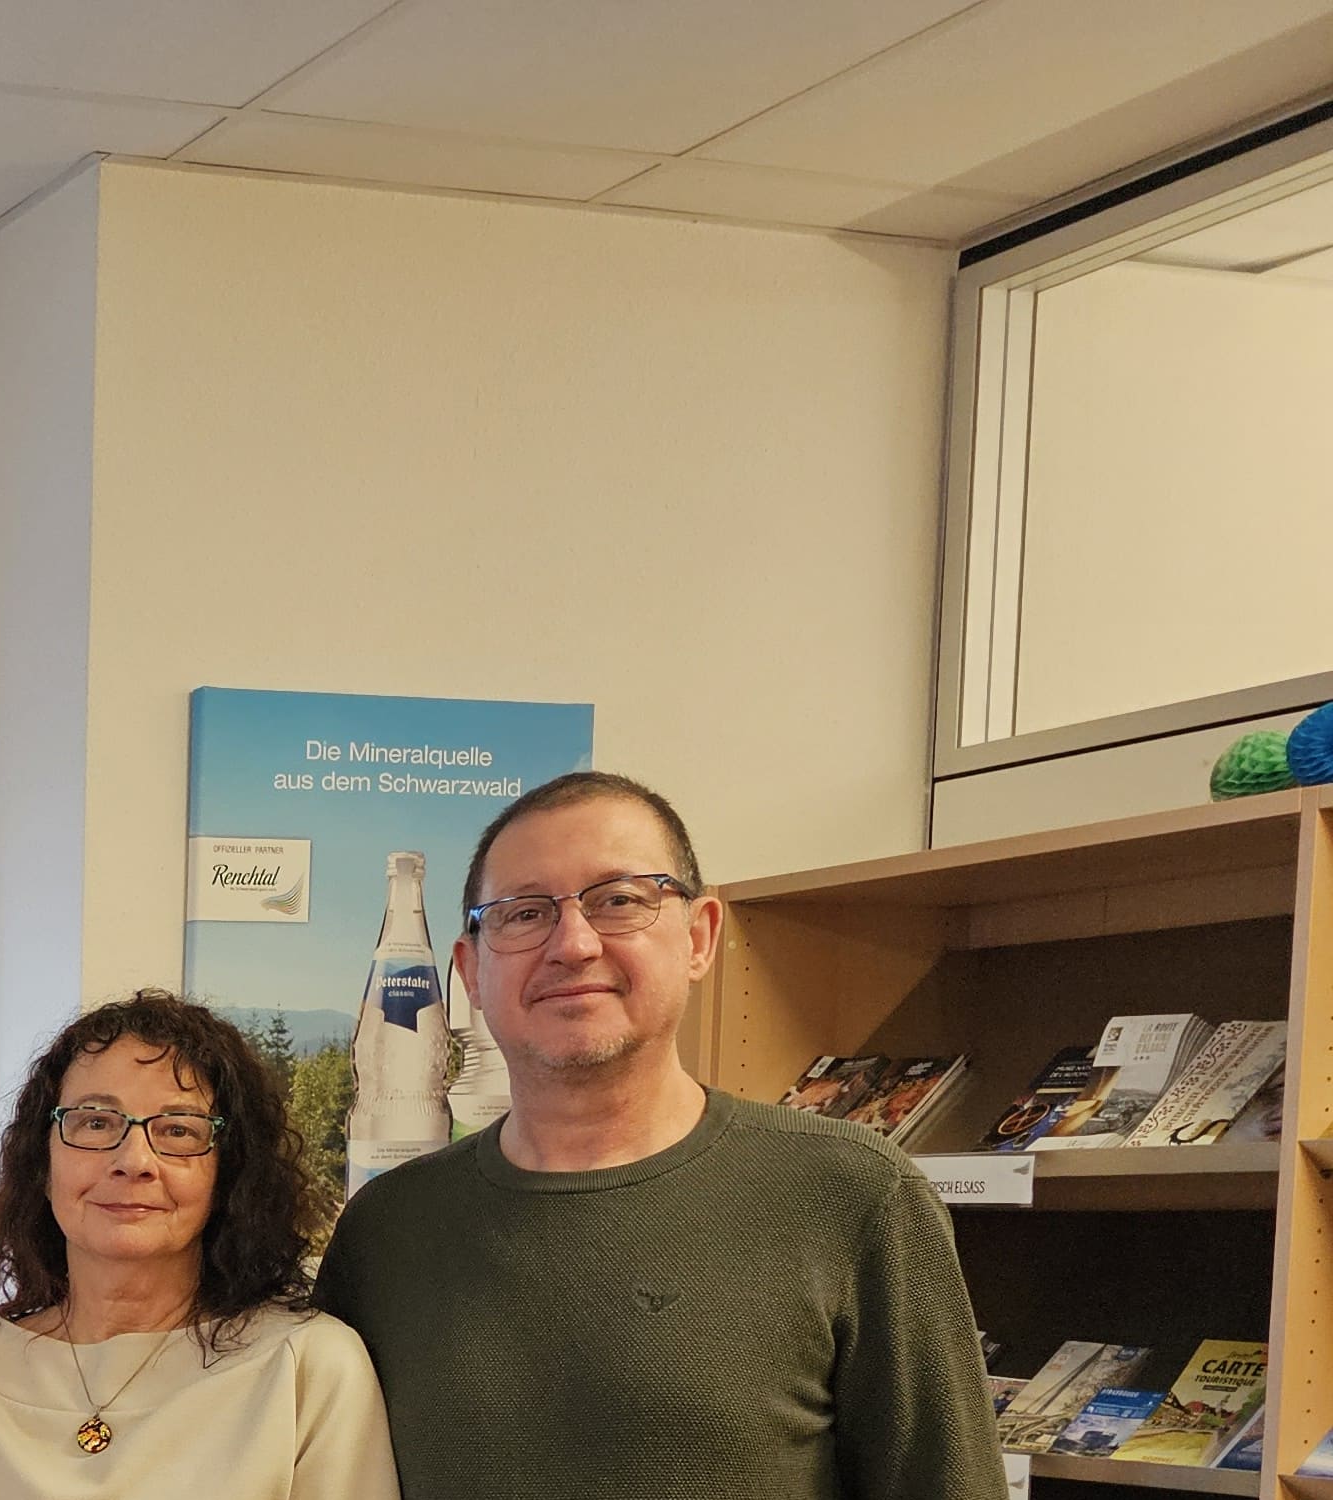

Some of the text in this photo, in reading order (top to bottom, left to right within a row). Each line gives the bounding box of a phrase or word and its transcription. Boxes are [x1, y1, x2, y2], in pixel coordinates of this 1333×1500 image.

[305, 740, 493, 769] Die Mineralquelle
[273, 771, 521, 798] aus dem Schwarzwald
[213, 845, 284, 855] OFFIZIELLER PARTNER
[212, 864, 281, 888] Renchtal
[376, 975, 430, 990] Peterstaler
[955, 1181, 986, 1194] ELSASS
[1201, 1359, 1265, 1377] CARTE
[1195, 1375, 1258, 1387] TOURISTIQUE
